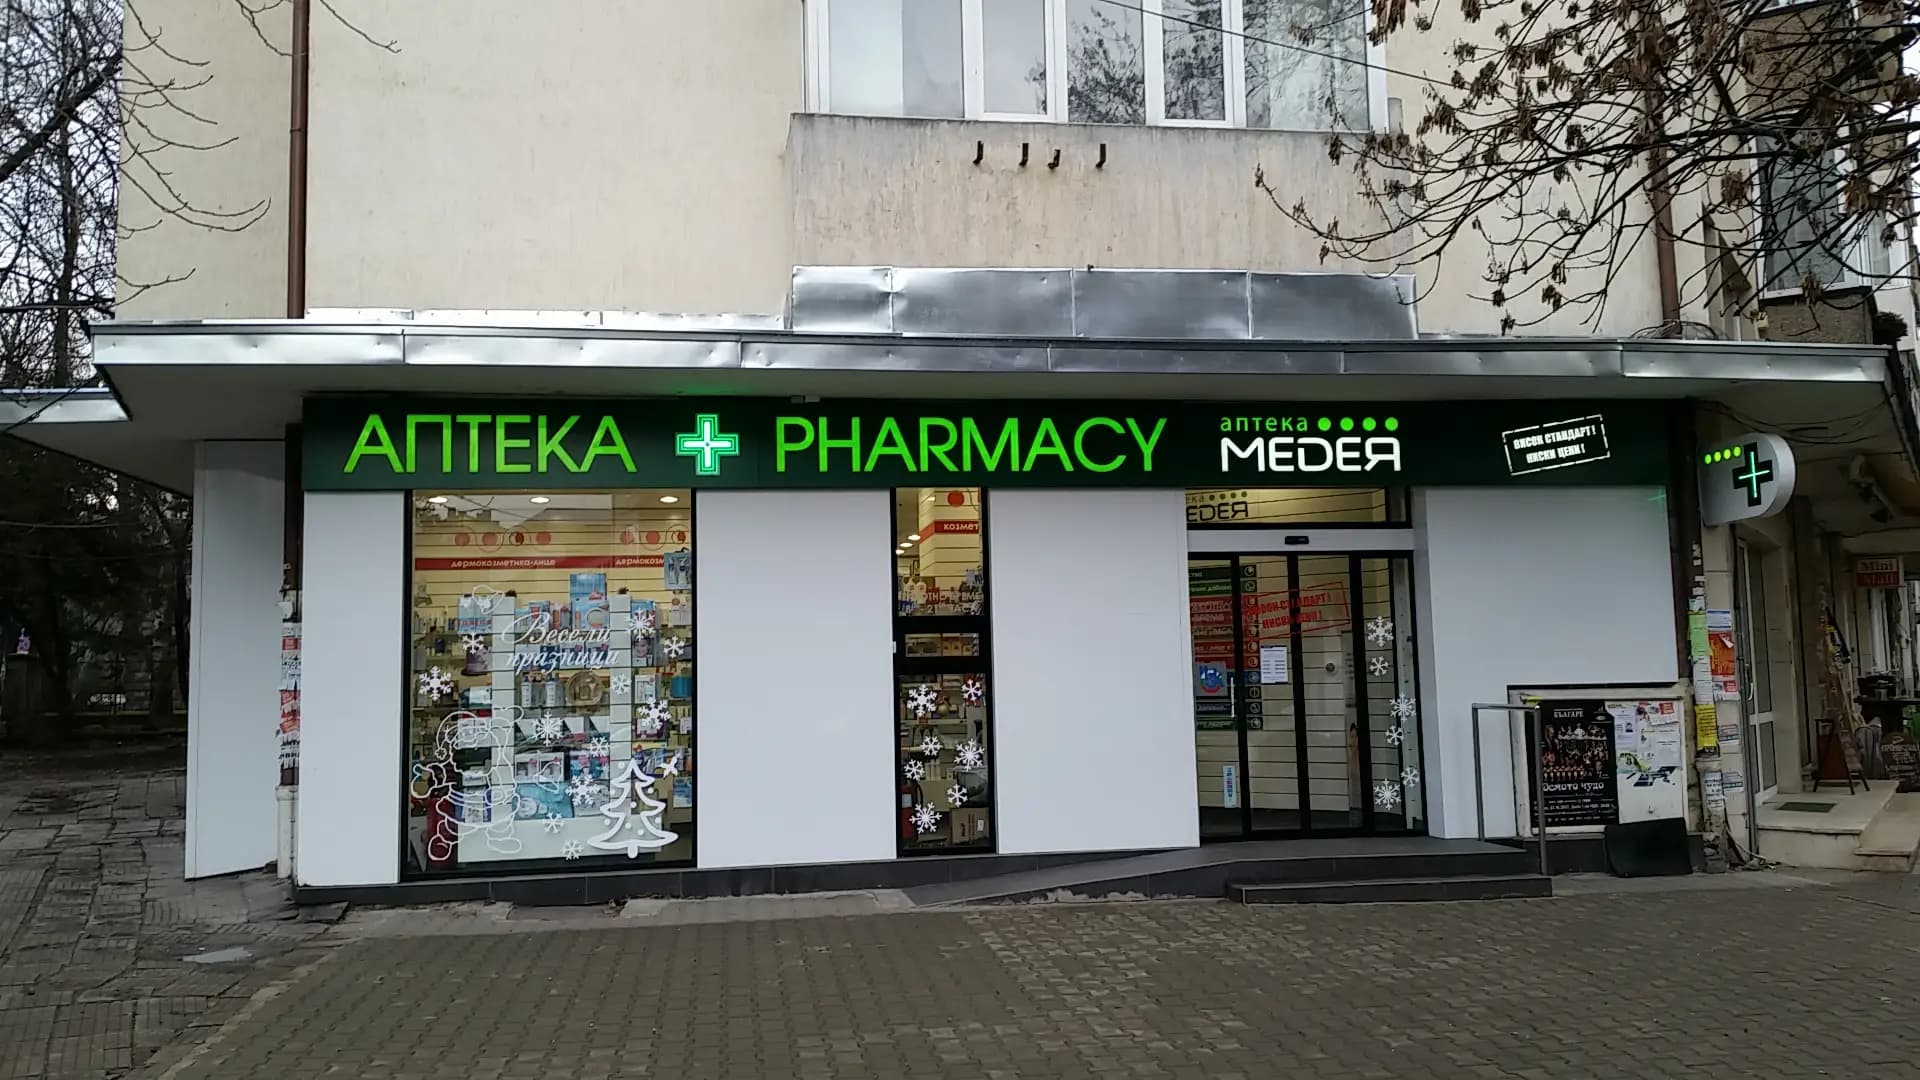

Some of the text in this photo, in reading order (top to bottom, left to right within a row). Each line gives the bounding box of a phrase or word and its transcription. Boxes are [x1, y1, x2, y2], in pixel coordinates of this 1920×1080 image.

[1220, 417, 1308, 432] аптека
[344, 414, 637, 473] АПТЕКА
[775, 416, 1168, 473] PHARMACY
[1512, 434, 1544, 450] ВИСОК
[1525, 448, 1557, 464] НИСКИ
[502, 612, 610, 644] Весели
[506, 652, 618, 675] празници
[1581, 782, 1605, 791] чудо
